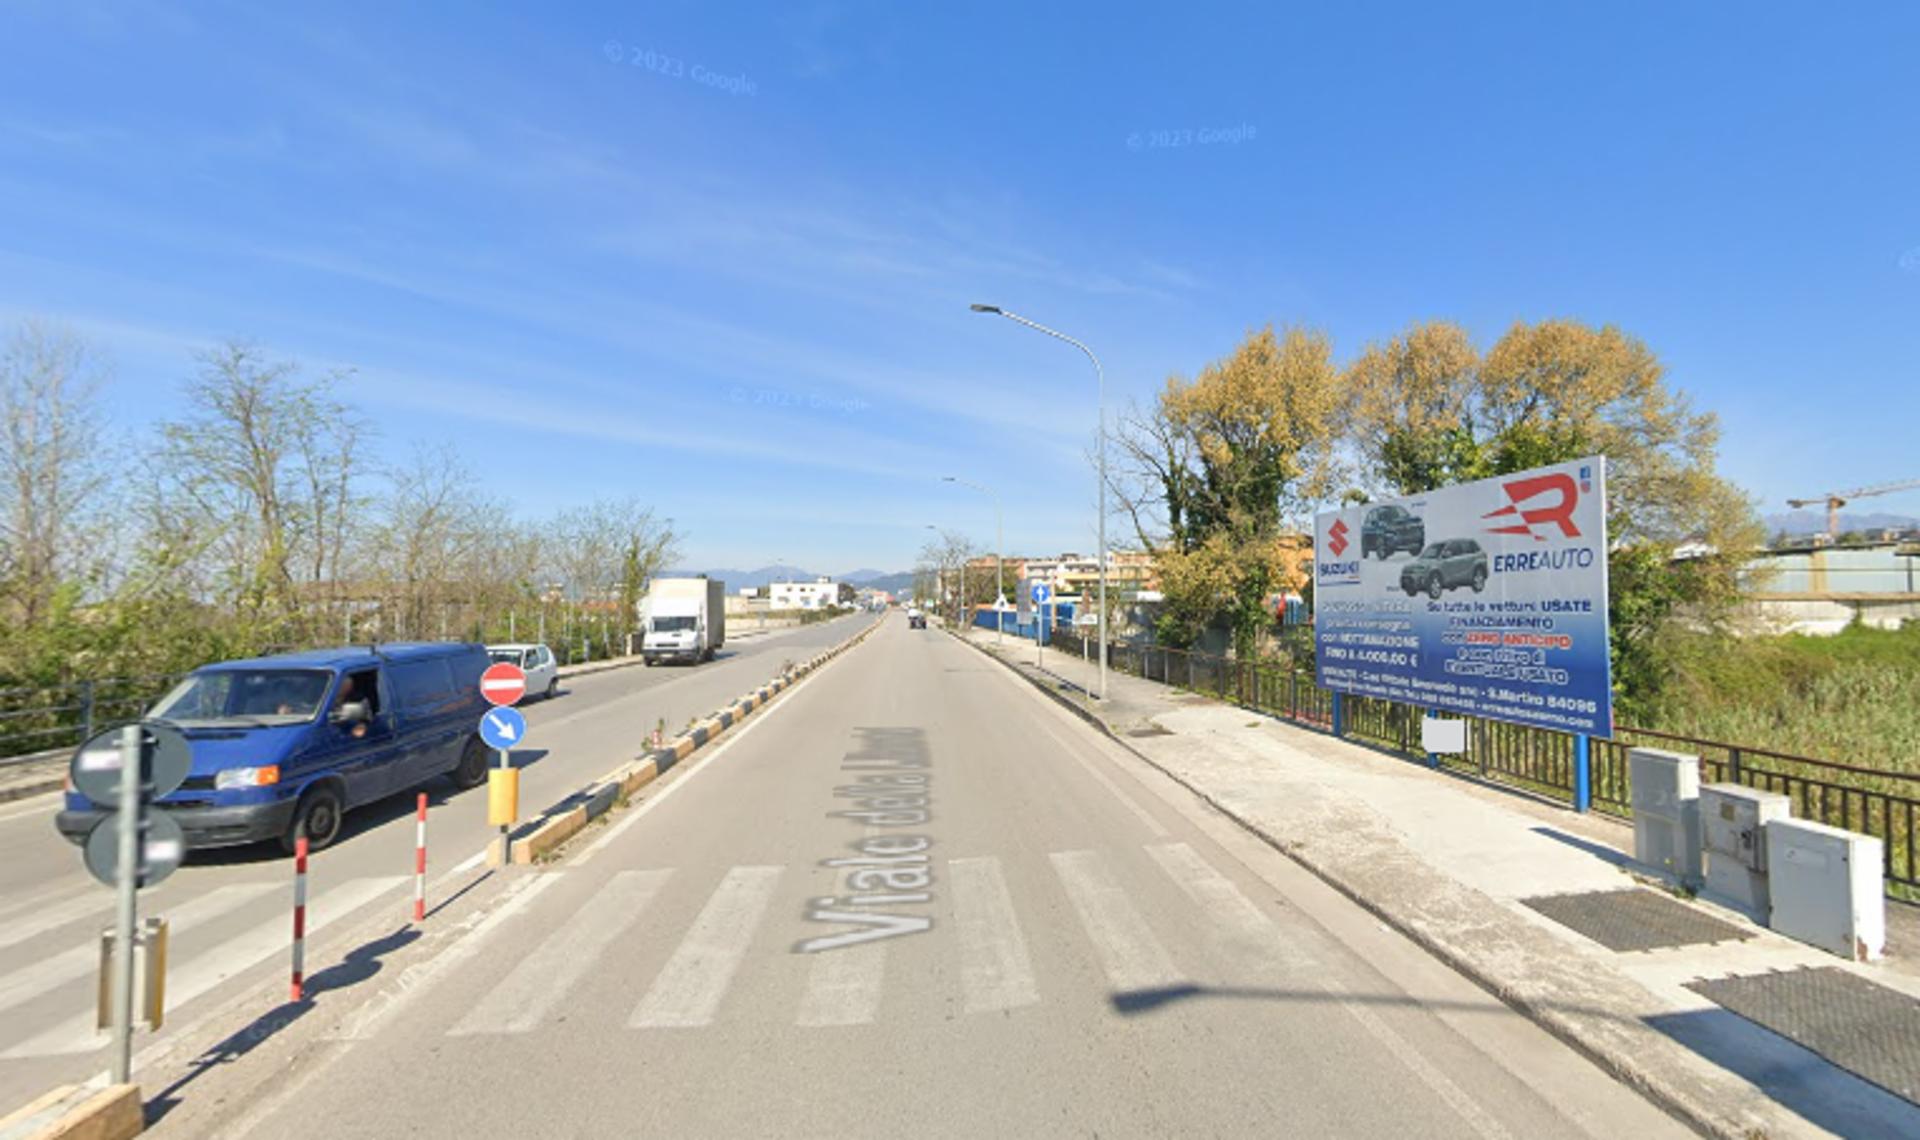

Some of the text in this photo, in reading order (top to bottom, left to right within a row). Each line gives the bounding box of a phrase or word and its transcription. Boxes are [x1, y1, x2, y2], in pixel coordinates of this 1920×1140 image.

[1493, 547, 1594, 573] ERREAUTO
[1541, 600, 1592, 613] USATE
[1450, 615, 1554, 630] FINANZIAMENTO
[1502, 632, 1572, 649] ANTICIPO
[1546, 695, 1597, 714] 84096
